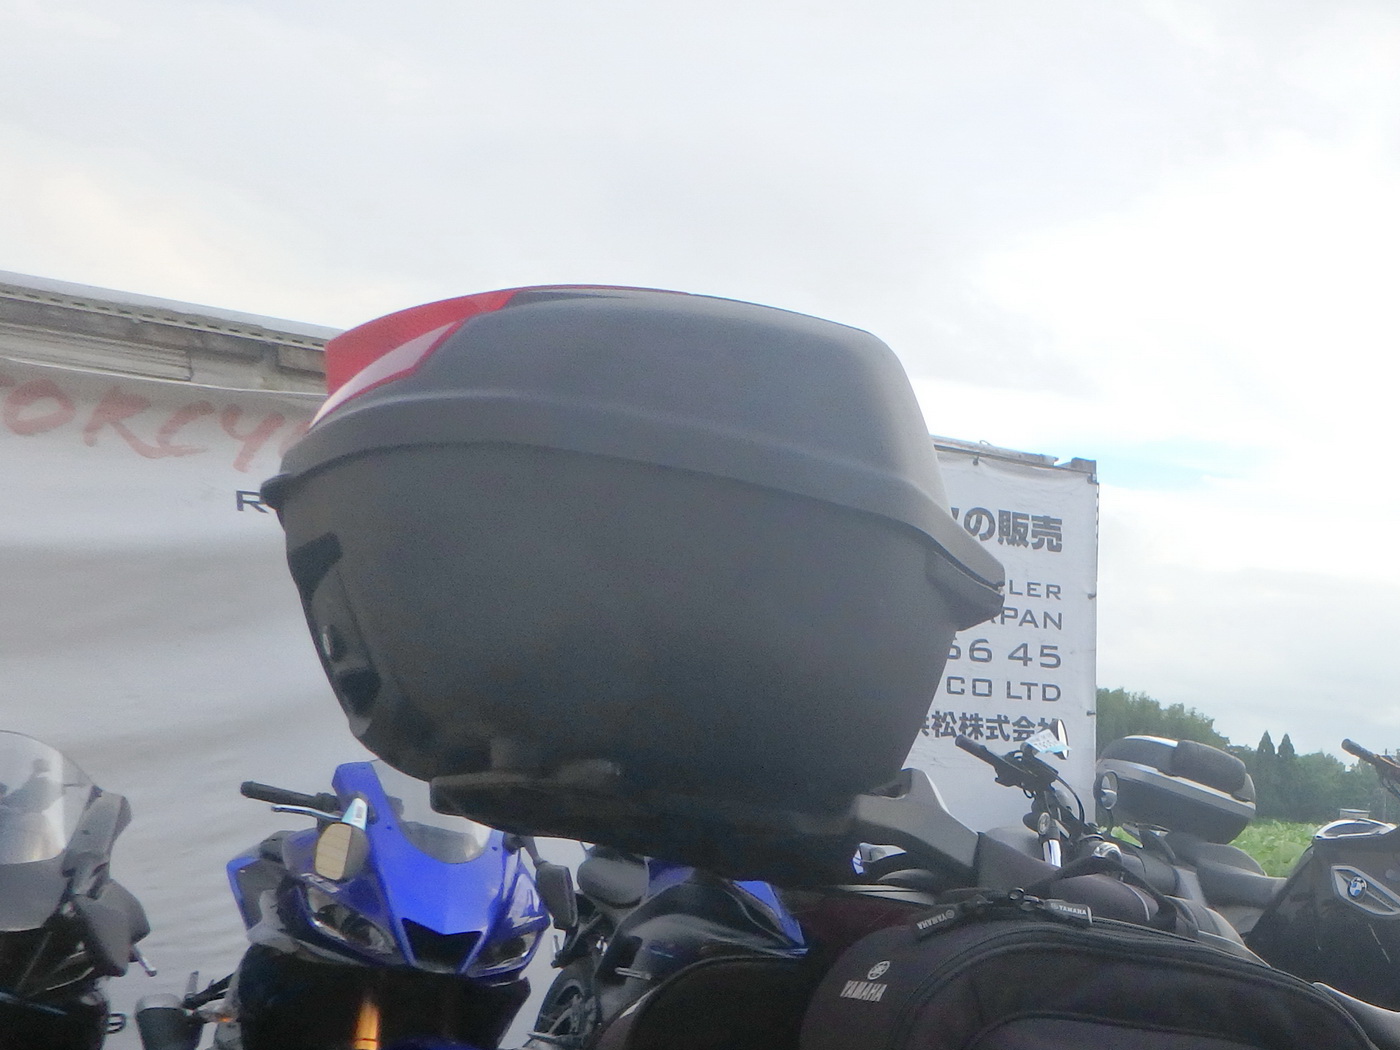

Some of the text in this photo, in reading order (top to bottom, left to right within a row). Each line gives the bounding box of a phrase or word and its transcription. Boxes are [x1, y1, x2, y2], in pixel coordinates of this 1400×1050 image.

[951, 507, 1062, 552] の販売
[991, 606, 1062, 630] PAN
[1008, 643, 1061, 668] 45
[946, 676, 1061, 702] CO LTD
[916, 913, 947, 930] YAMAHA
[1059, 904, 1087, 915] YAMAHA
[840, 980, 887, 1002] YAMAHA
